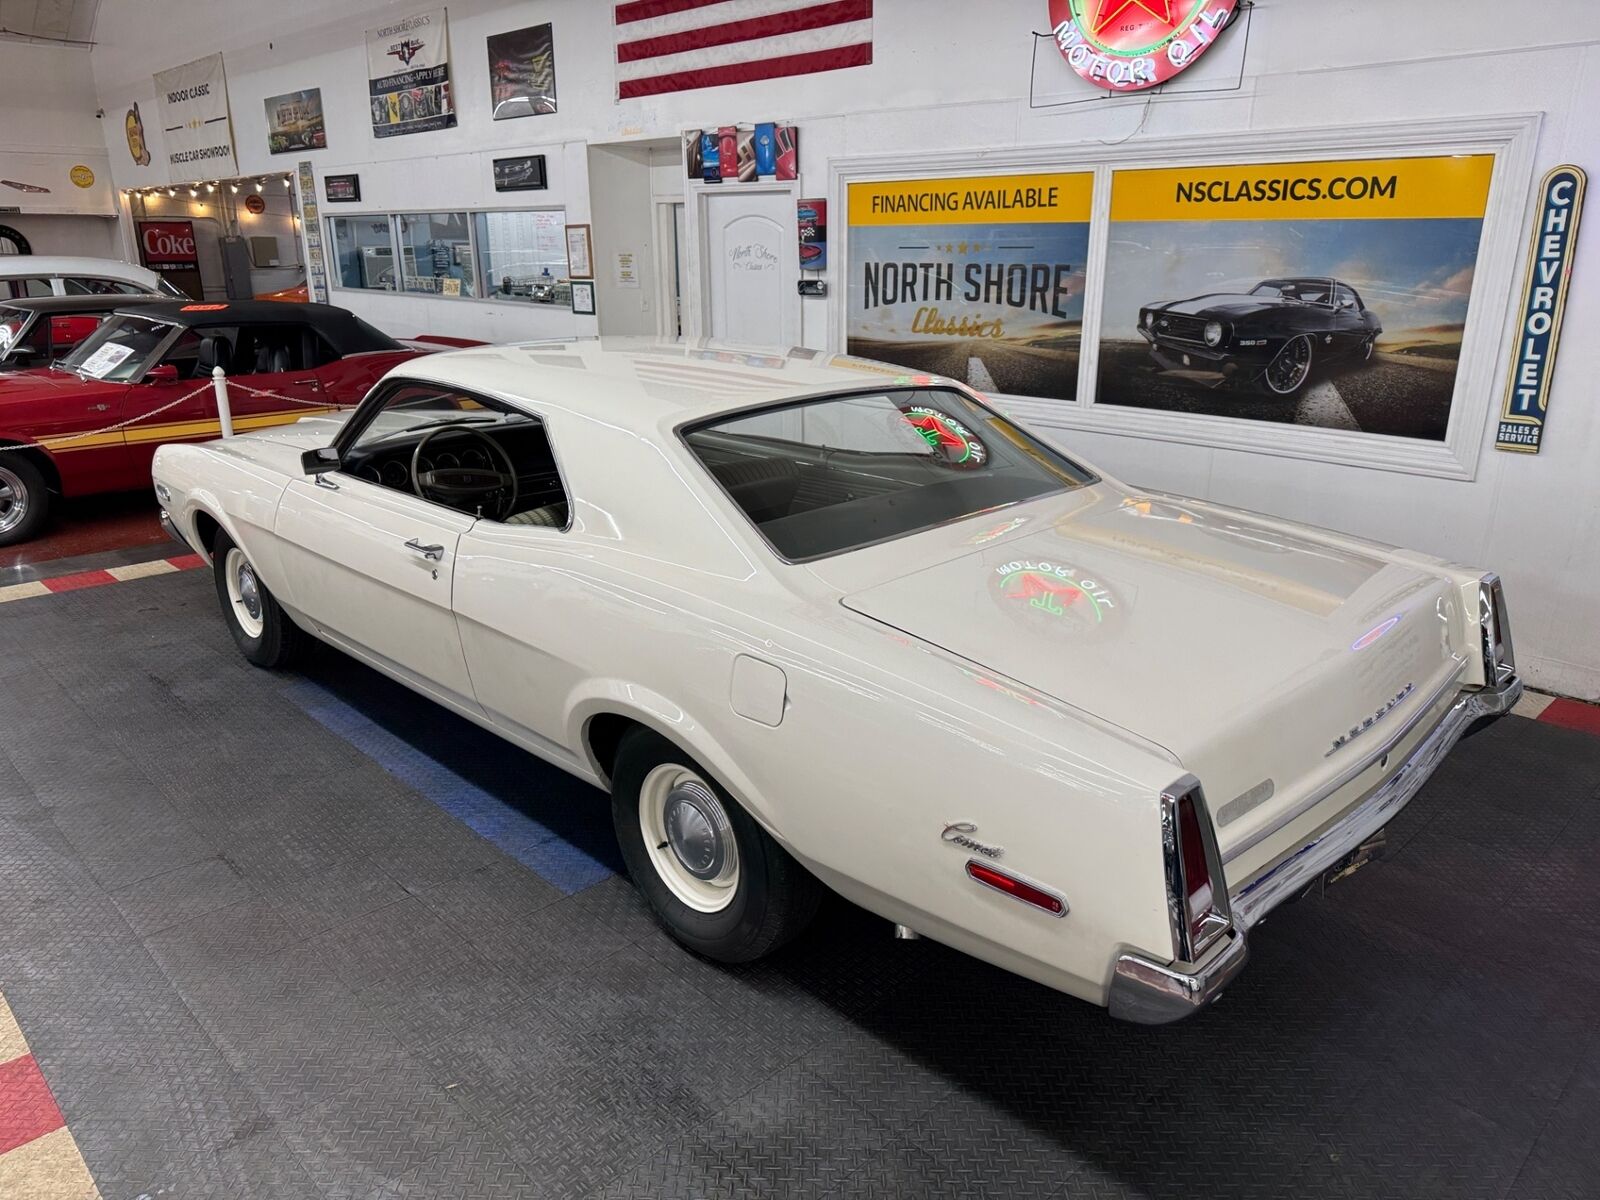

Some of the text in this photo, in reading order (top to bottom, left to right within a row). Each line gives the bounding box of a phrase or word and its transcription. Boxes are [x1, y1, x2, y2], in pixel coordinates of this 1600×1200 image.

[1120, 24, 1135, 32] REG
[1053, 20, 1157, 86] MOTOR
[1167, 7, 1229, 67] OIL
[416, 70, 432, 80] APPLY
[167, 83, 210, 104] INDOOR CLASSIC
[170, 144, 230, 164] MUSCLE CAR SHOWROOM
[872, 187, 1059, 214] FINANCING AVAILABLE
[1175, 175, 1398, 203] NSCLASSICS.COM
[143, 229, 196, 255] Coke
[864, 262, 1071, 319] NORTH SHORE
[1518, 180, 1574, 411] CHEVROLET
[911, 307, 1005, 339] Classics
[1498, 432, 1539, 444] SERVICE
[1500, 423, 1540, 436] SALES &
